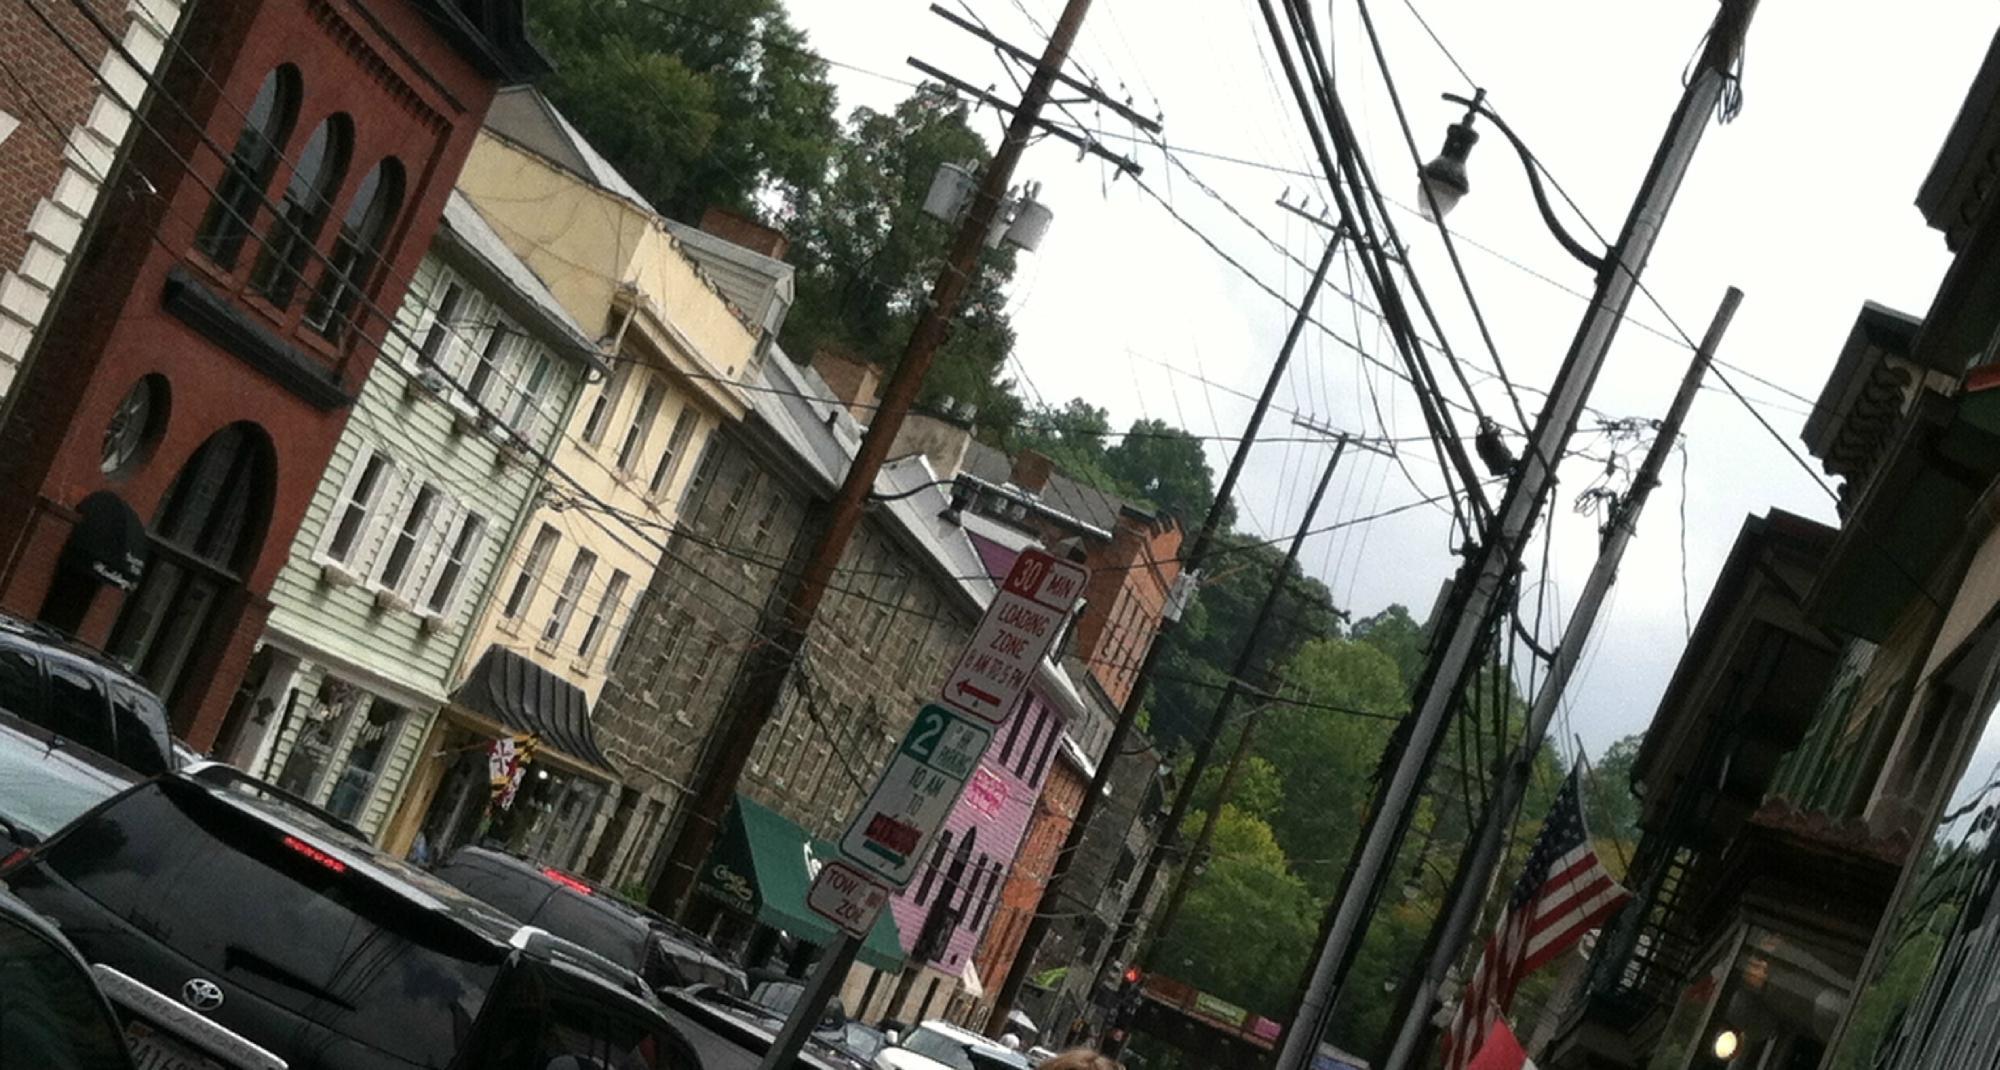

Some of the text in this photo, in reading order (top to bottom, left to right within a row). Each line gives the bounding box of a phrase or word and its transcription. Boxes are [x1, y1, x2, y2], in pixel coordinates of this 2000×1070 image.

[1013, 559, 1076, 599] 30 MIN
[998, 601, 1051, 638] LOADING
[990, 629, 1029, 660] ZONE
[909, 713, 944, 755] 2
[910, 765, 928, 789] 10
[922, 774, 946, 799] AM
[826, 868, 859, 896] TOW
